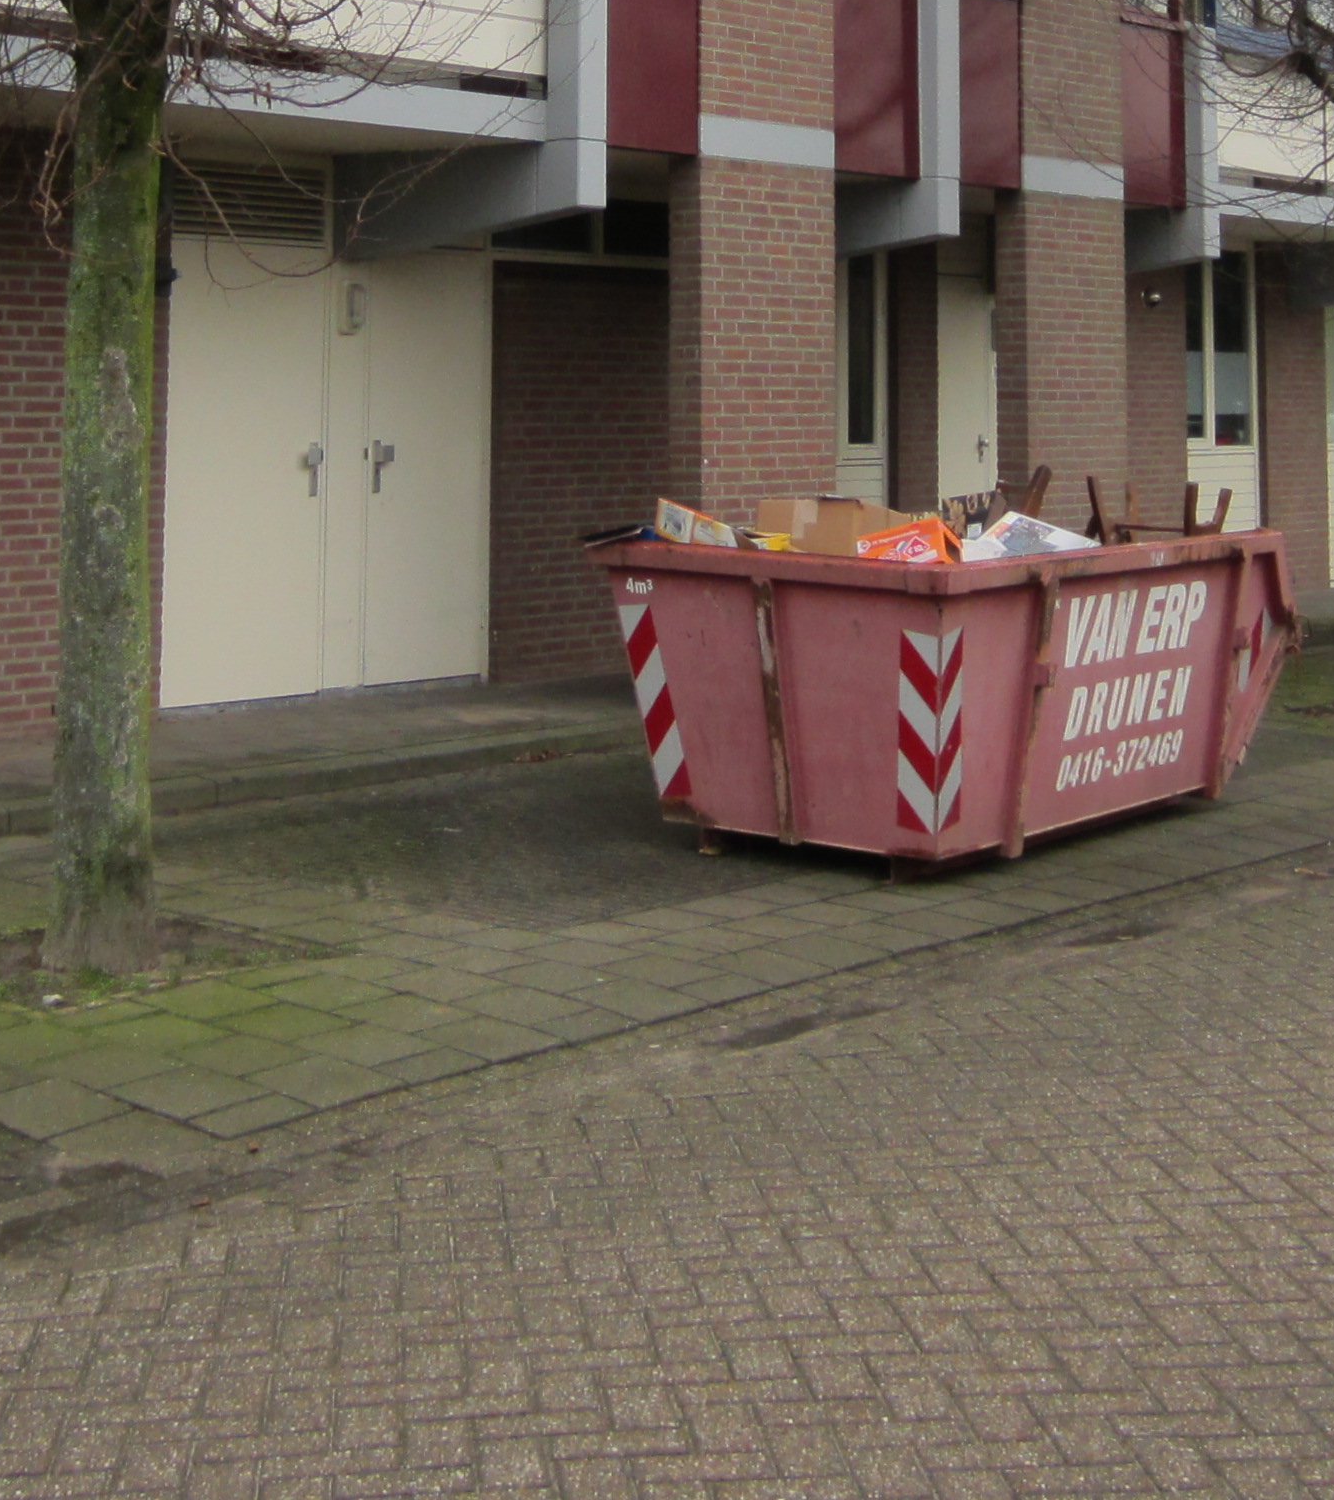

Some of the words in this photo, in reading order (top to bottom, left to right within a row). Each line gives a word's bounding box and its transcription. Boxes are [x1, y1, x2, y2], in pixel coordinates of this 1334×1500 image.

[1063, 589, 1139, 668] VAN
[1135, 580, 1207, 655] ERP
[1062, 665, 1193, 741] DRUNEN
[1055, 728, 1184, 792] 0416-372469
